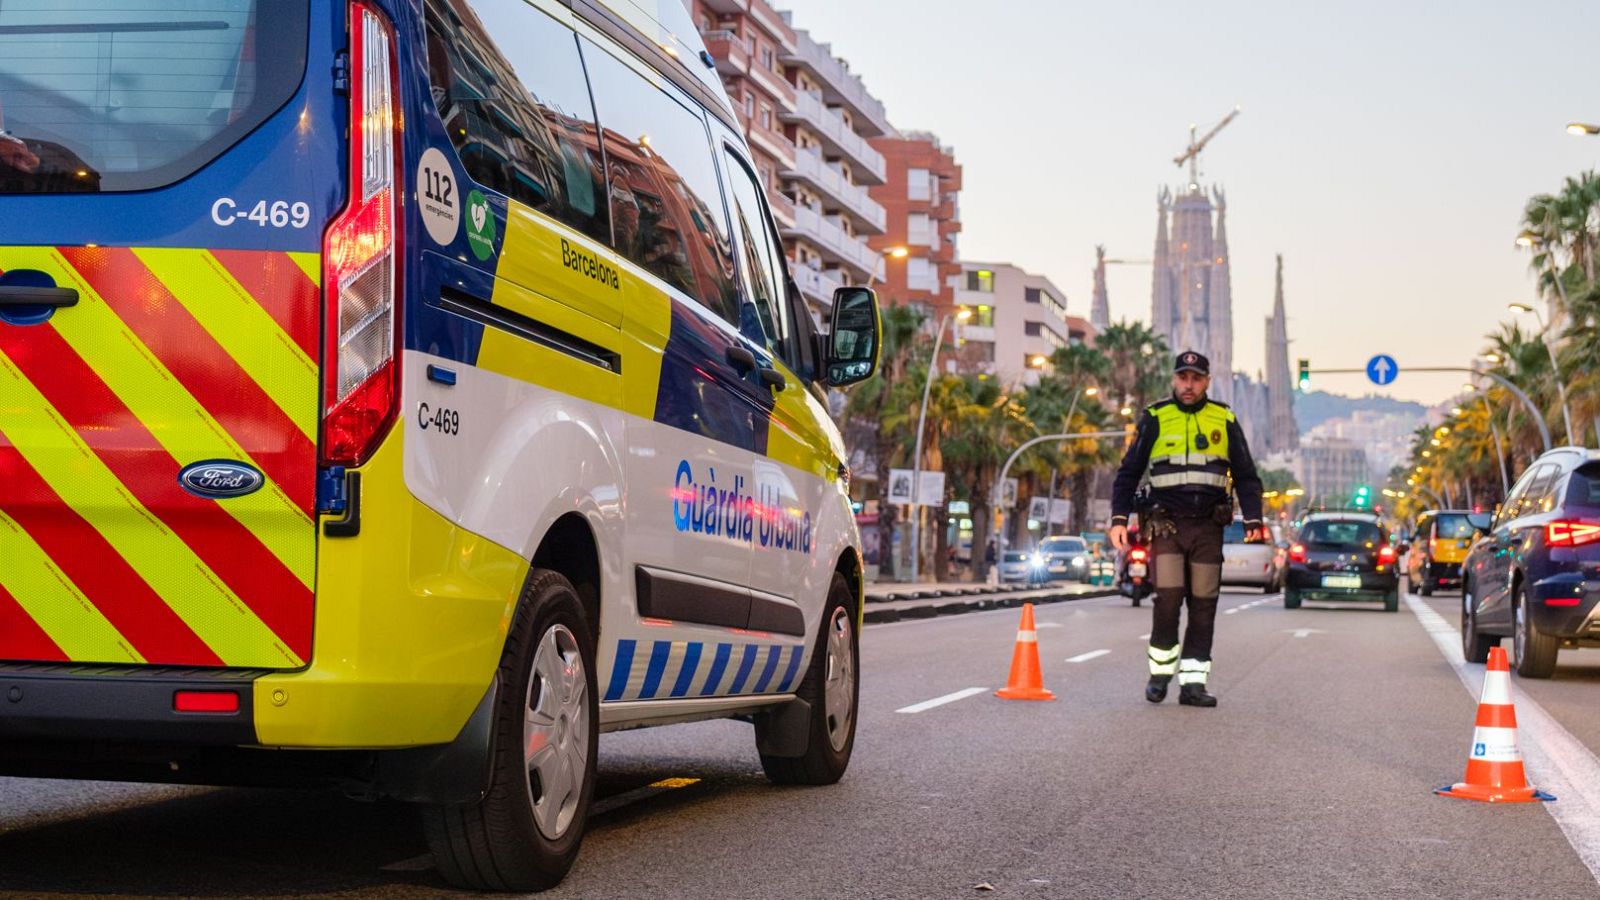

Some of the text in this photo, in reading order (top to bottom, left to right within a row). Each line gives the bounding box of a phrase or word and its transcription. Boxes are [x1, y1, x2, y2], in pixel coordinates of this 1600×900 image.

[424, 167, 453, 208] 112
[211, 197, 310, 229] C-469
[560, 238, 619, 290] Barcelona
[418, 402, 459, 436] C-469
[199, 469, 244, 487] Ford
[673, 459, 811, 554] Guàrdia Urbana
